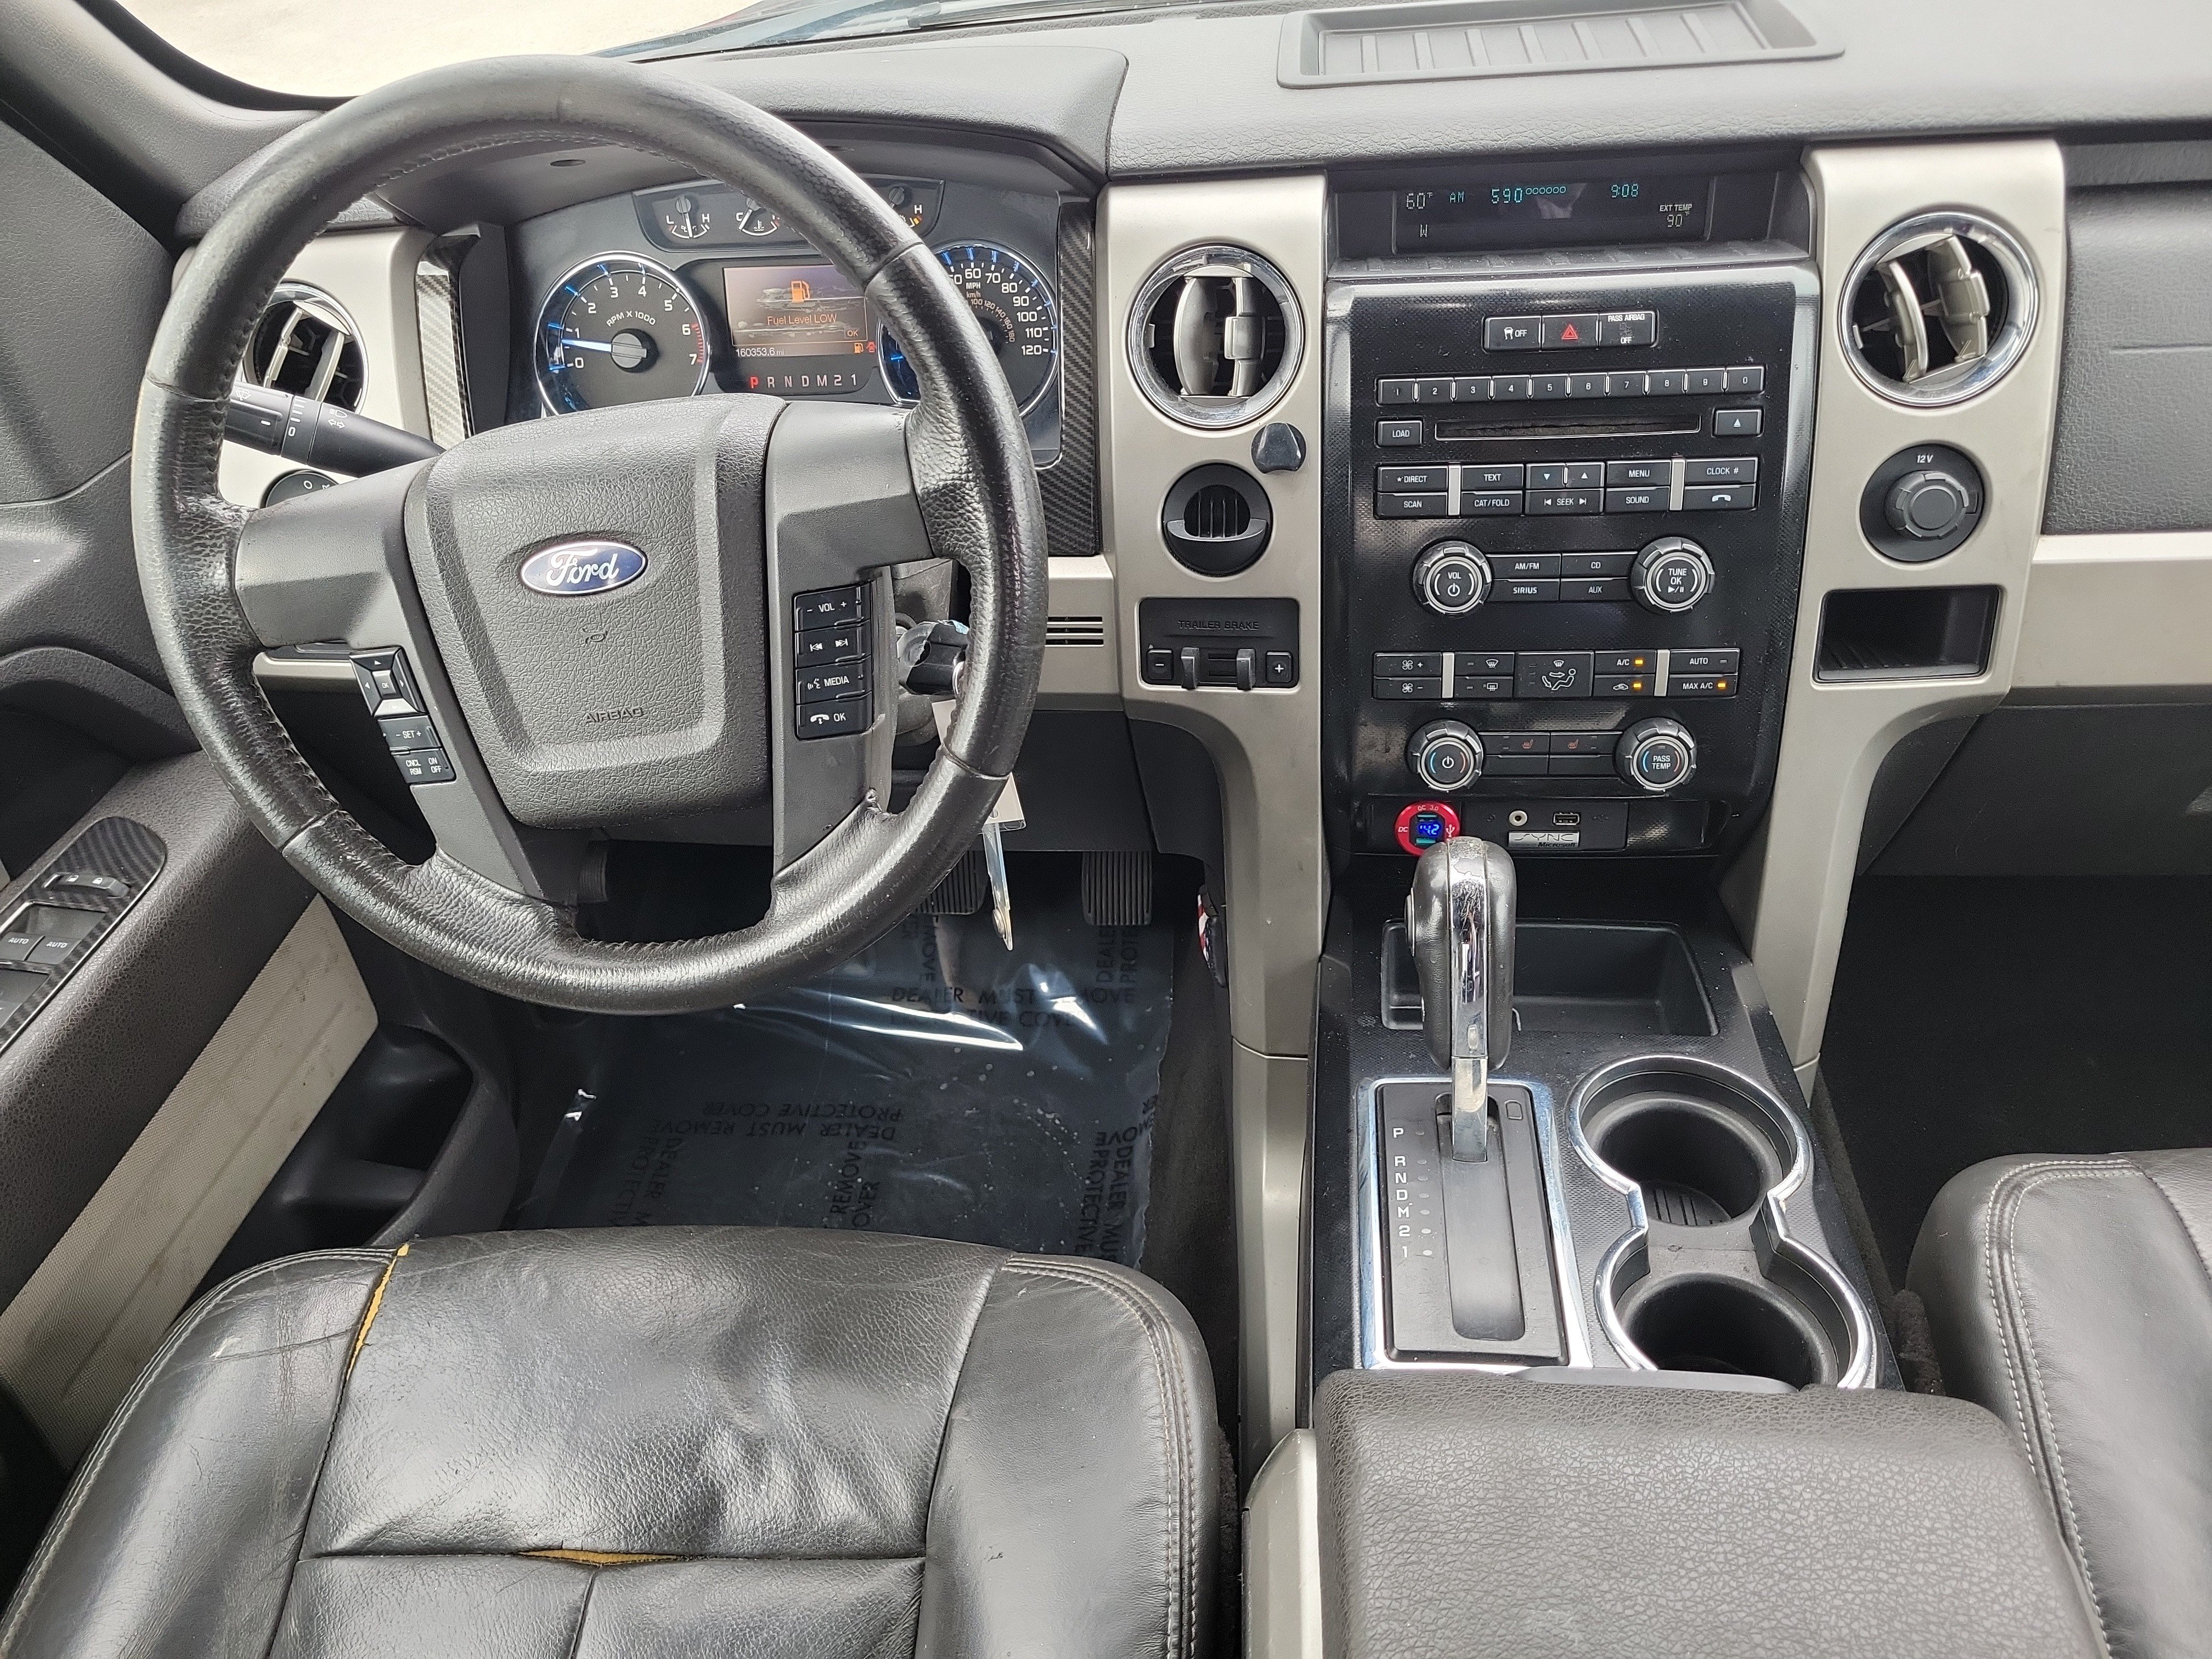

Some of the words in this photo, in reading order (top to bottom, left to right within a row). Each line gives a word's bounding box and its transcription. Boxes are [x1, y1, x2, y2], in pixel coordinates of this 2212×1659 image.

[1611, 183, 1639, 198] 9:08
[1449, 191, 1464, 203] AM
[914, 205, 922, 214] H
[1674, 203, 1692, 211] TEMP
[666, 216, 674, 224] L
[702, 213, 710, 223] H
[736, 212, 743, 222] C
[1420, 224, 1427, 238] W
[964, 268, 981, 279] 60
[985, 273, 1001, 284] 70
[610, 287, 619, 298] 3
[637, 286, 647, 297] 4
[1001, 282, 1018, 294] 80
[966, 290, 981, 298] km/h
[664, 300, 673, 311] 5
[984, 300, 996, 309] 120
[1013, 296, 1029, 307] 90
[588, 303, 596, 313] 2
[995, 307, 1006, 318] 140
[606, 312, 624, 327] RPM
[635, 311, 656, 325] 1000
[767, 316, 786, 326] Fuel
[788, 314, 812, 325] Level
[814, 313, 837, 324] LOW
[1017, 311, 1037, 322] 100
[574, 328, 580, 338] 1
[682, 324, 691, 335] 6
[1025, 328, 1042, 338] 110
[1021, 345, 1042, 356] 120
[575, 357, 584, 368] 0
[690, 354, 698, 365] 7
[751, 376, 759, 388] P
[768, 376, 775, 388] R
[785, 376, 792, 387] N
[802, 375, 809, 387] D
[817, 375, 827, 386] M
[834, 374, 842, 386] 2
[851, 374, 857, 385] 1
[1917, 454, 1933, 464] 12V
[1403, 475, 1427, 483] DIRECT
[1628, 470, 1650, 478] MENU
[1474, 499, 1510, 507] CAT/FOLD
[1556, 498, 1574, 506] SEEK
[1626, 496, 1650, 504] SOUND
[545, 549, 619, 586] Ford
[1671, 577, 1682, 585] OK
[818, 603, 836, 613] VOL
[1177, 620, 1221, 630] TRAILER
[1224, 621, 1260, 630] BRAKE
[823, 675, 850, 687] MEDIA
[585, 707, 645, 724] AIRBAG
[833, 712, 847, 722] OK
[402, 730, 415, 739] SET
[405, 759, 421, 767] CNCL
[431, 765, 442, 774] OFF
[1514, 833, 1573, 842] SYNC
[1096, 926, 1116, 983] DEALE
[1393, 1127, 1404, 1138] P
[1395, 1156, 1406, 1167] R
[1395, 1172, 1407, 1183] N
[1396, 1189, 1408, 1200] D
[1398, 1206, 1409, 1218] M
[1399, 1225, 1410, 1237] 2
[1402, 1246, 1408, 1258] 1
